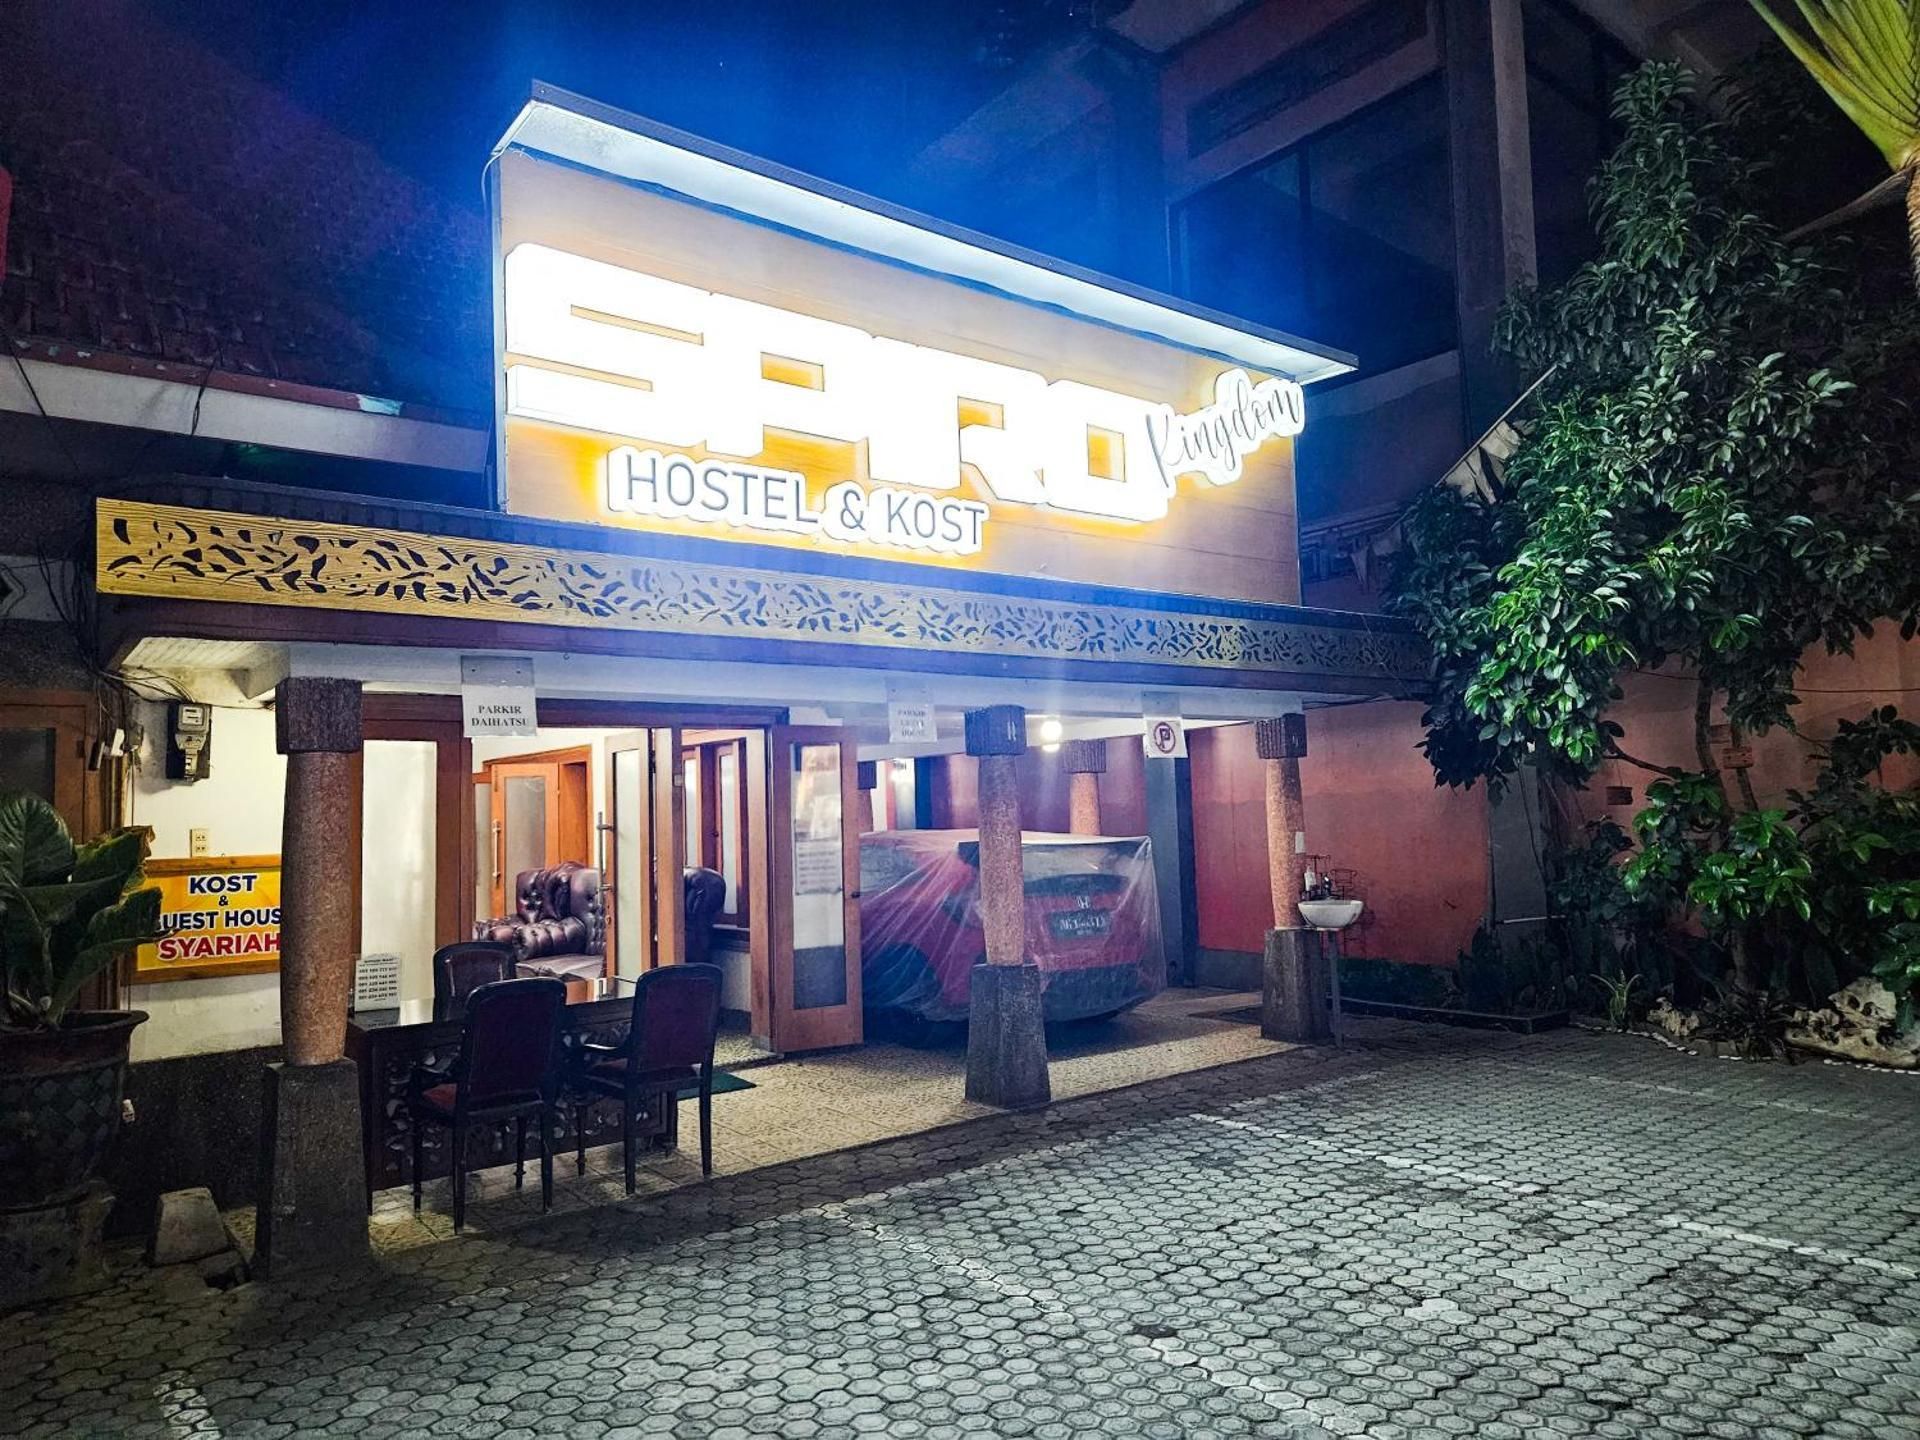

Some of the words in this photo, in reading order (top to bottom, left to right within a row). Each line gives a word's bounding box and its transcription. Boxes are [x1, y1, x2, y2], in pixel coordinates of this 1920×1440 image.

[1145, 378, 1300, 489] Kingdom
[626, 453, 819, 525] HOSTEL
[840, 489, 866, 532] &
[886, 492, 985, 546] KOST
[478, 704, 522, 715] PARKIR
[189, 875, 258, 894] KOST
[218, 895, 229, 906] &
[160, 911, 219, 930] UEST
[225, 908, 282, 927] HOUS
[160, 932, 281, 960] SYARIAH
